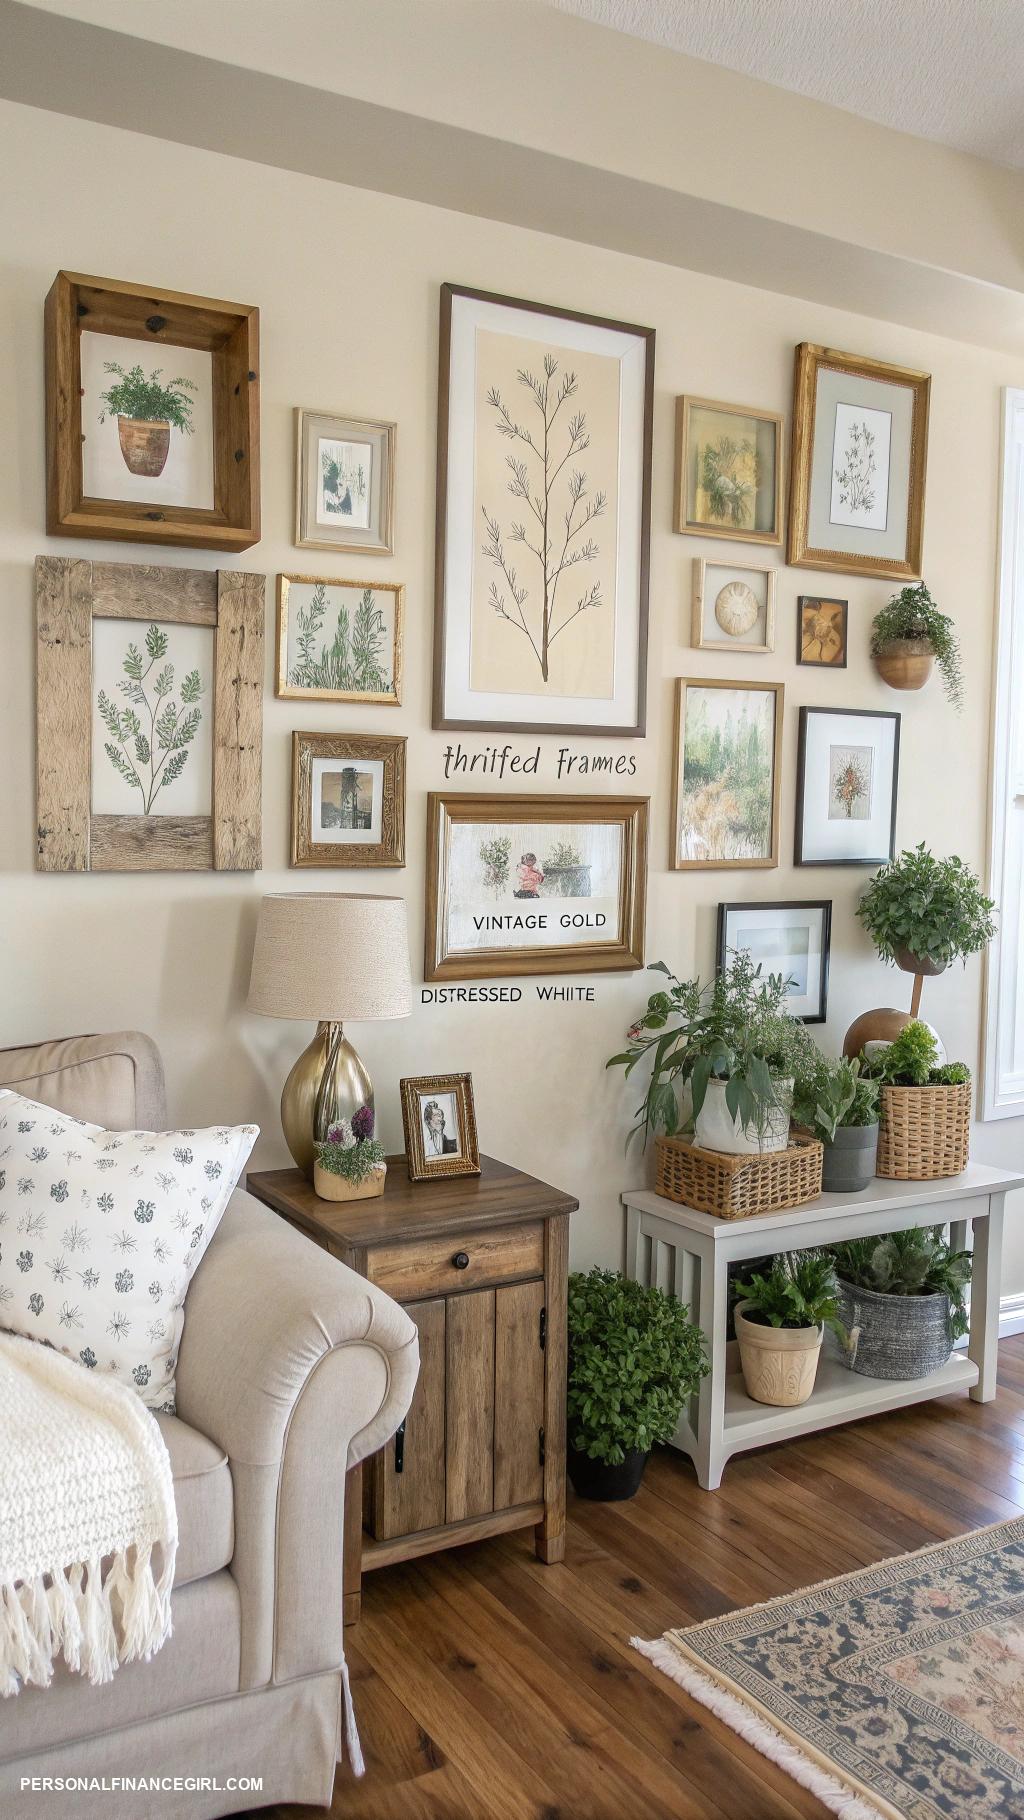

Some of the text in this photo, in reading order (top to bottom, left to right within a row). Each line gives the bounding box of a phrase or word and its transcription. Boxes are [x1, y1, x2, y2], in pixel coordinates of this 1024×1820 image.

[472, 913, 606, 931] VINTAGE GOLD
[421, 987, 522, 1004] DISTRESSED
